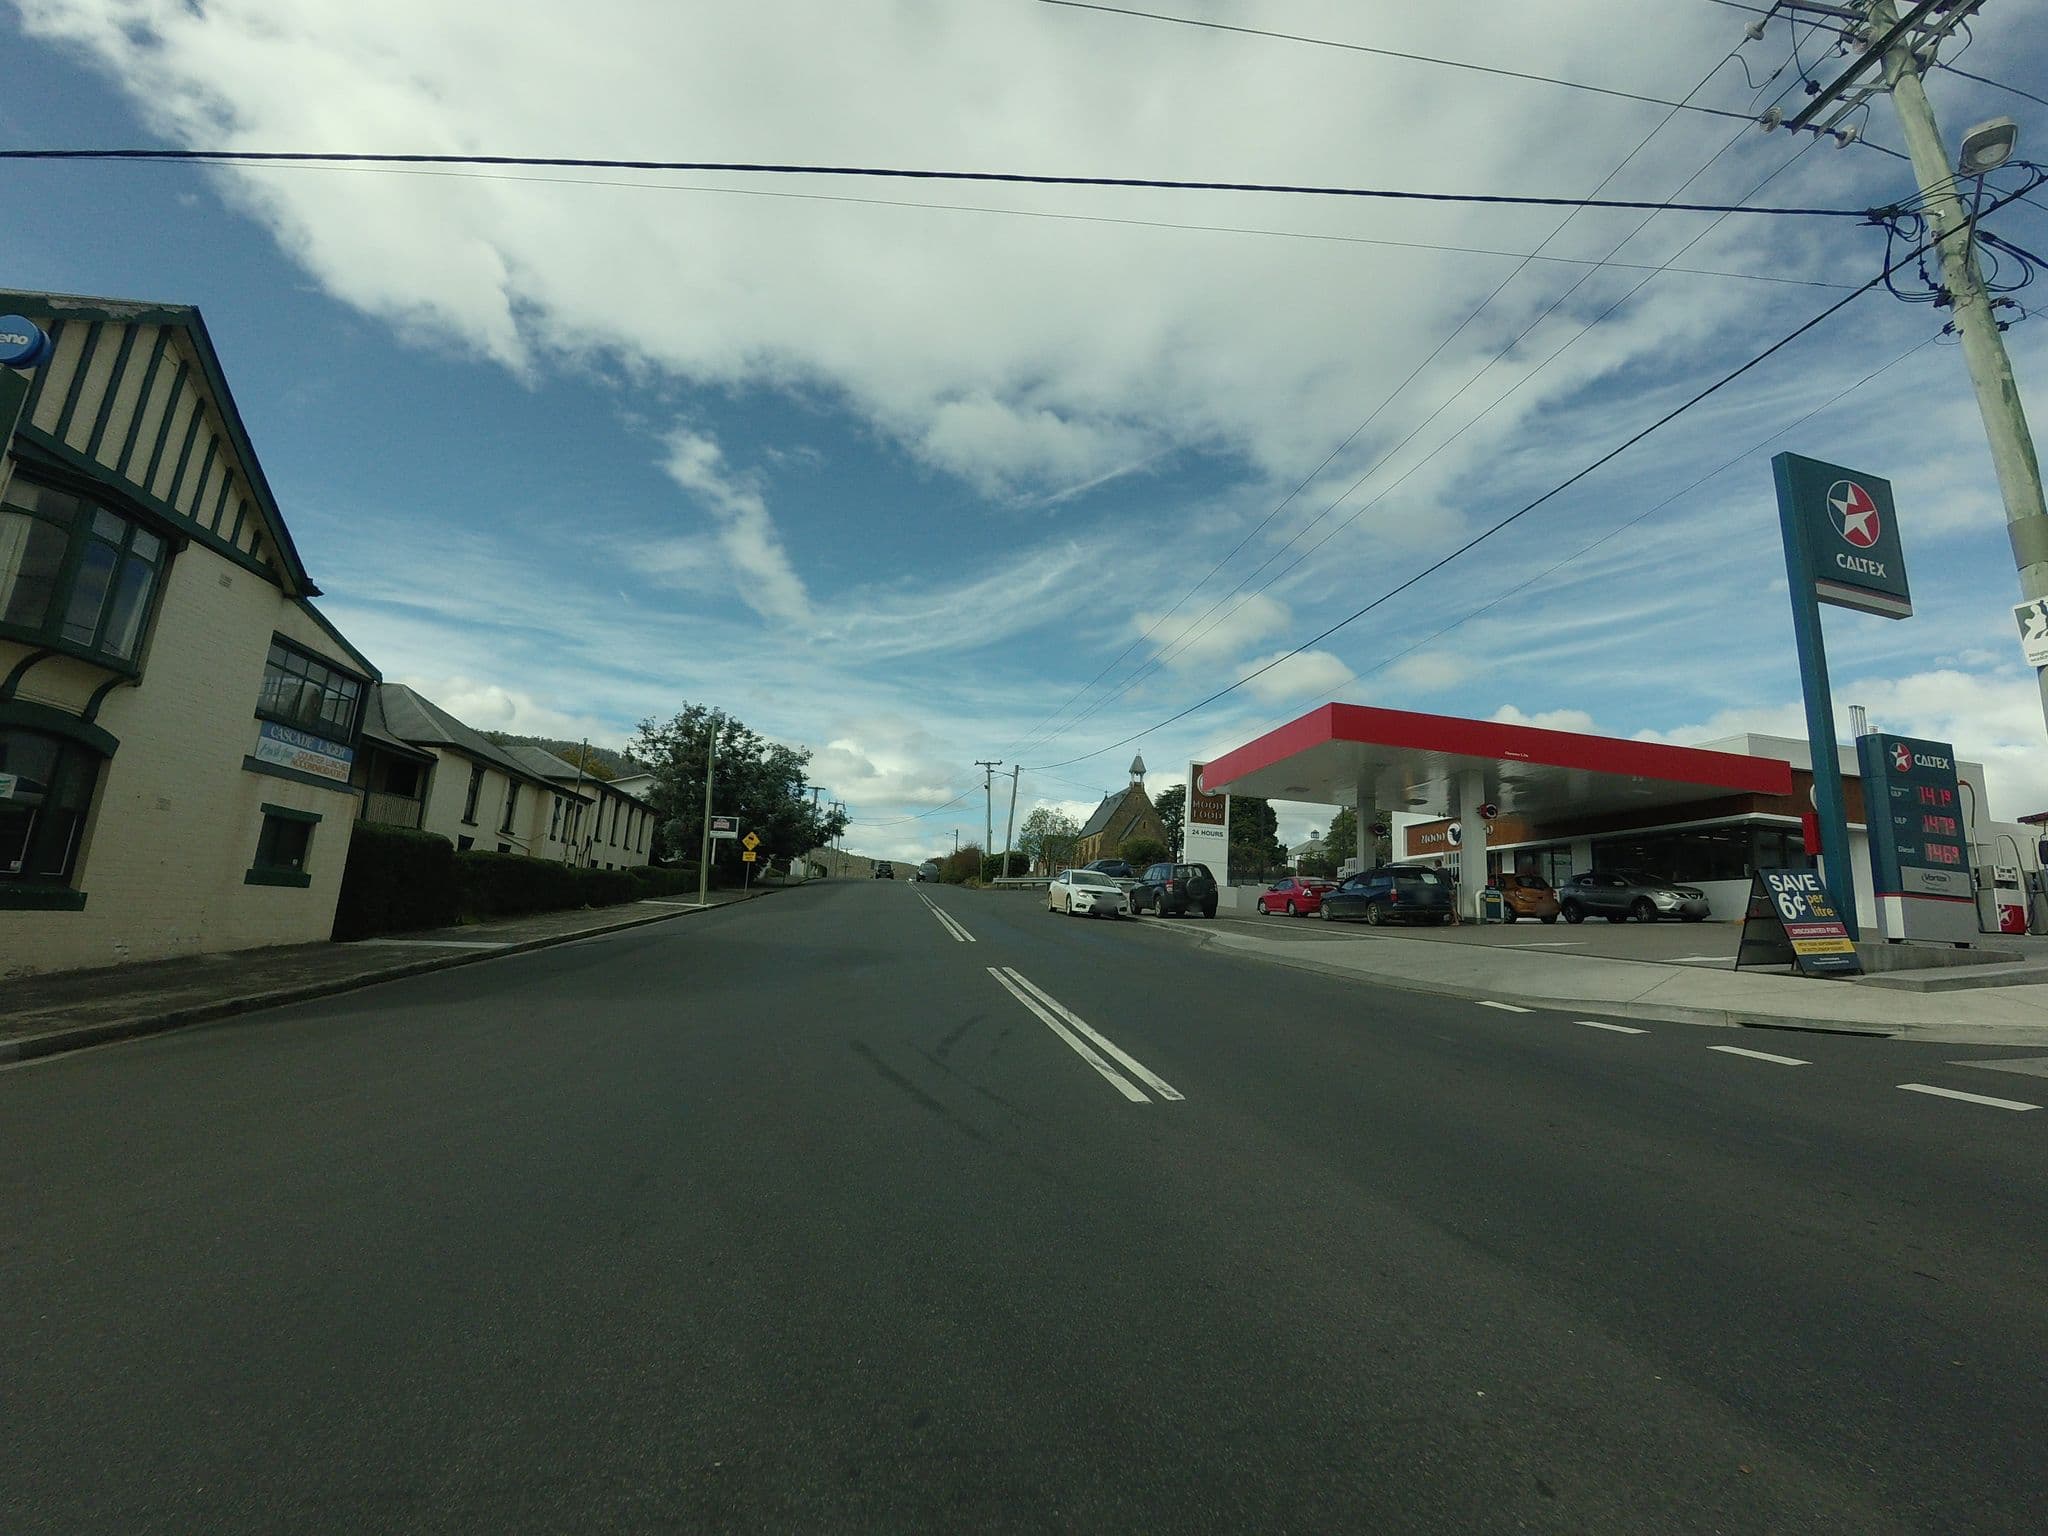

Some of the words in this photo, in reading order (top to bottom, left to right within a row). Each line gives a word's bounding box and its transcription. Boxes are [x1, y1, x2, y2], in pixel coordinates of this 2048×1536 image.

[0, 333, 28, 345] eno
[1836, 553, 1887, 578] CALTEX
[270, 726, 314, 748] CASCADE
[318, 740, 346, 759] LAGER
[1914, 754, 1950, 770] CALTEX
[1201, 830, 1224, 838] HOURS
[1768, 874, 1820, 892] SAVE
[1806, 894, 1824, 907] per
[1812, 905, 1835, 917] litre
